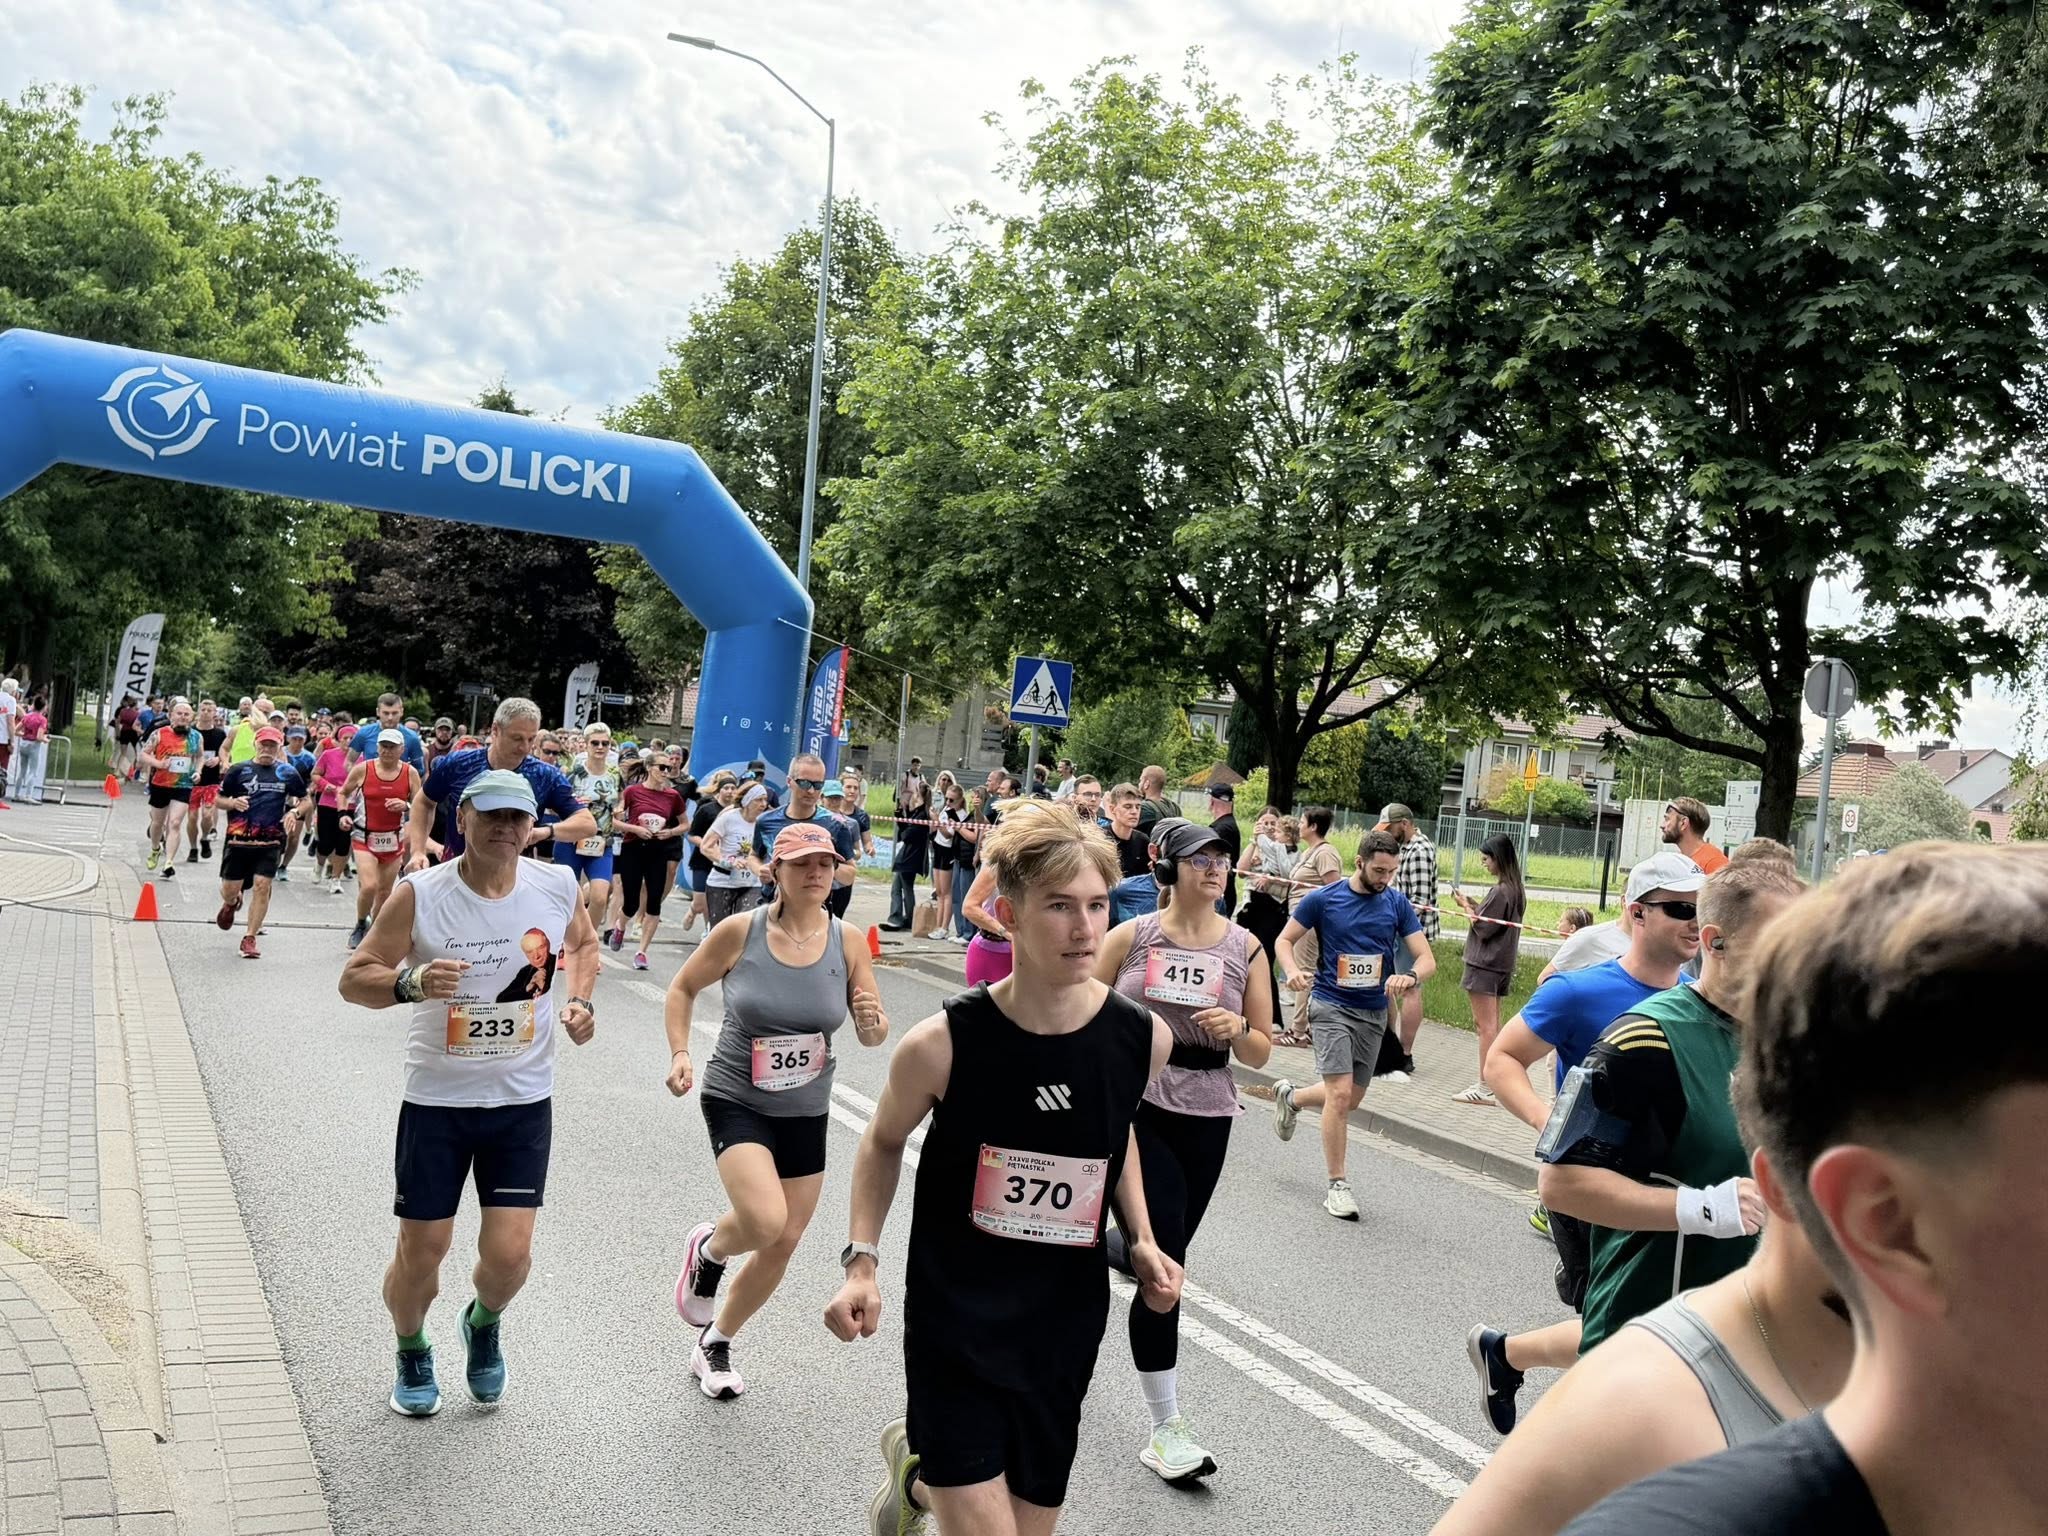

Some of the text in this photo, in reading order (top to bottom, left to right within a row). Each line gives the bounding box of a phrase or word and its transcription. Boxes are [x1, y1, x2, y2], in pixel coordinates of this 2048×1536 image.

[237, 403, 631, 504] Powiat POLICKI
[126, 645, 150, 695] ART
[824, 668, 838, 726] TRANS
[810, 736, 820, 757] ED
[375, 837, 392, 845] 398
[584, 840, 600, 849] 277
[1163, 965, 1205, 985] 415
[1348, 963, 1373, 975] 303
[468, 1018, 515, 1038] 233
[770, 1049, 810, 1070] 365
[1030, 1158, 1056, 1168] POLICKA
[1003, 1175, 1073, 1210] 370
